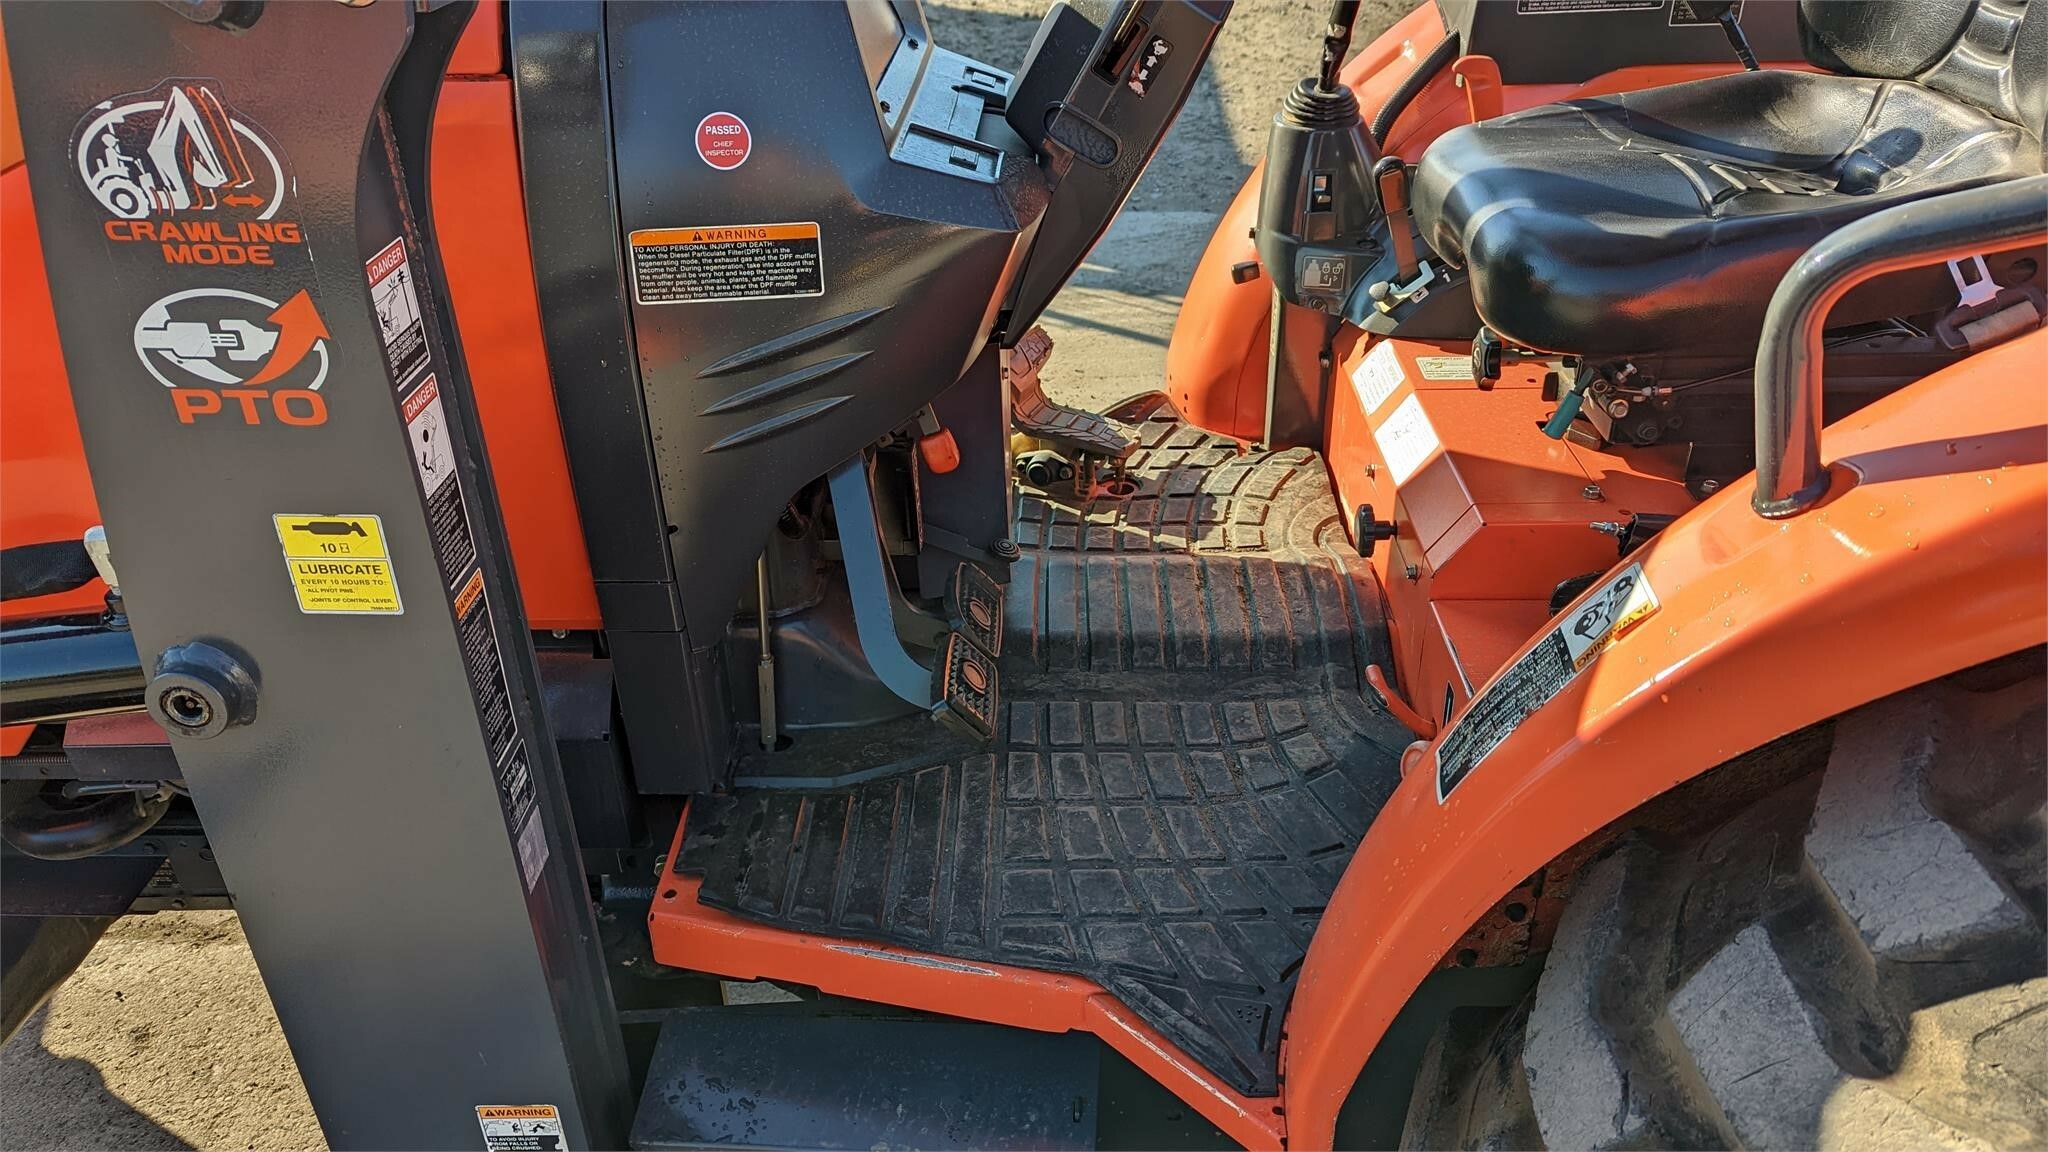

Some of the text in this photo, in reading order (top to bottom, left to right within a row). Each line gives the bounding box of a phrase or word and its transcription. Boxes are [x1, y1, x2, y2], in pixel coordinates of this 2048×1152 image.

[705, 125, 742, 135] PASSED
[713, 140, 734, 148] CHIEF
[104, 220, 302, 244] CRAWLING
[706, 229, 766, 241] WARNING
[164, 244, 274, 266] MODE
[728, 248, 763, 256] Filter(DPF)
[372, 246, 402, 279] DANGER
[406, 381, 436, 414] DANGER
[170, 388, 328, 426] PTO
[320, 543, 336, 553] 10
[298, 564, 382, 575] LUBRICATE
[1576, 616, 1635, 668] WRNING
[494, 1108, 552, 1116] WARNING
